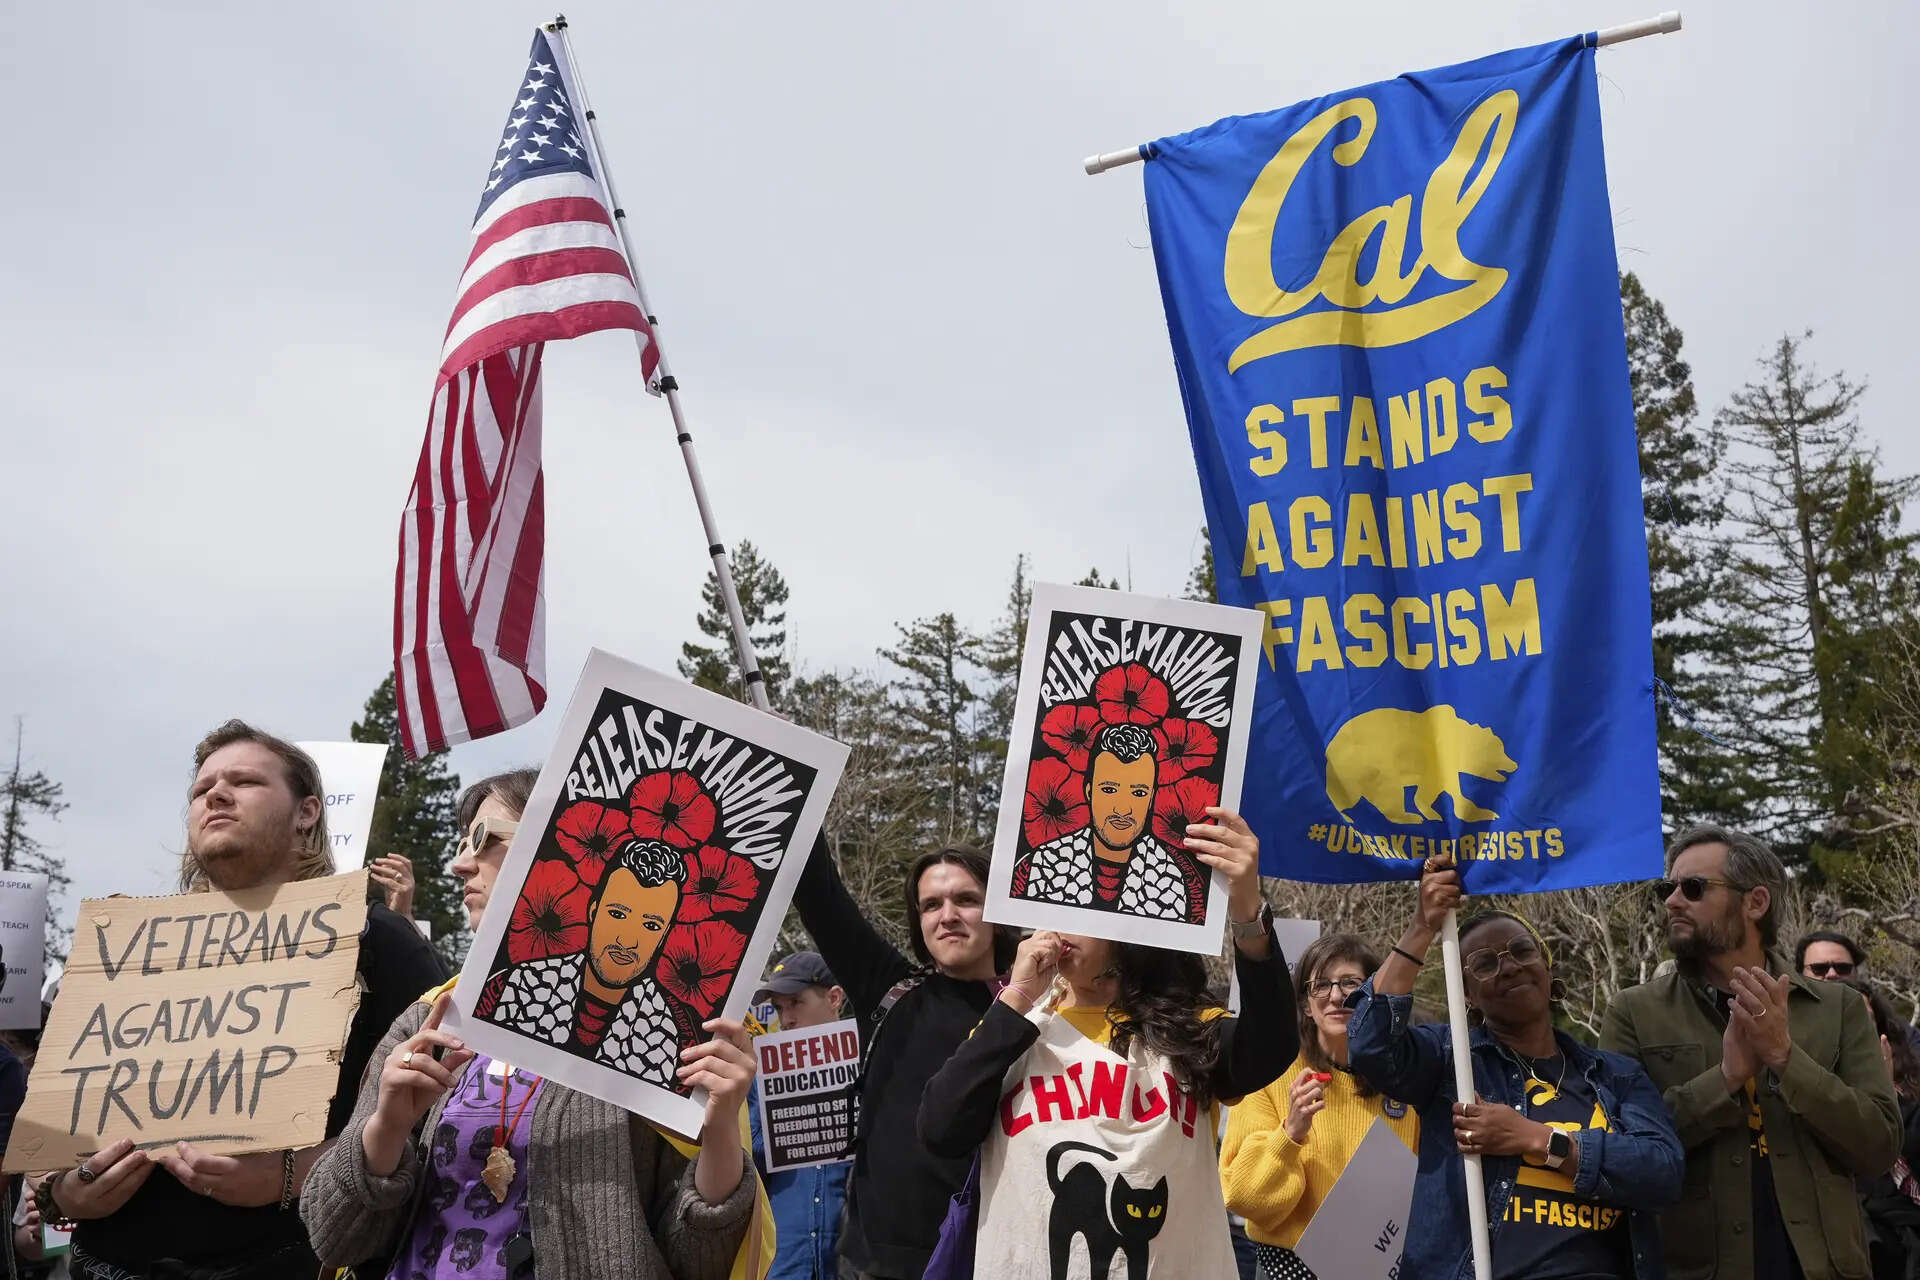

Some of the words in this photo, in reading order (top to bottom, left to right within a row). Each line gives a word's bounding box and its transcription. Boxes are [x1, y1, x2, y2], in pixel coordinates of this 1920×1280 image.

[1224, 89, 1520, 374] Cal
[1245, 366, 1512, 478] STANDS
[1240, 473, 1533, 577] AGAINST
[1255, 577, 1542, 673] FASCISM
[1041, 617, 1134, 708] RELEASE
[1134, 624, 1235, 728] MAHMOUD
[325, 793, 355, 806] OFF
[567, 705, 697, 801] RELEASE
[687, 729, 803, 870] MAHMOUD
[6, 881, 32, 890] SPEAK
[2, 921, 29, 930] TEACH
[96, 903, 342, 982] VETERANS
[68, 981, 311, 1060] AGAINST
[760, 1031, 859, 1074] DEFEND
[60, 1045, 298, 1137] TRUMP
[771, 1103, 816, 1120] FREEDOM
[817, 1101, 831, 1114] TO
[773, 1117, 818, 1134] FREEDOM
[819, 1115, 833, 1128] TO
[774, 1131, 820, 1147] FREEDOM
[820, 1128, 834, 1141] TO
[786, 1147, 806, 1160] FOR
[1374, 1218, 1400, 1253] WE
